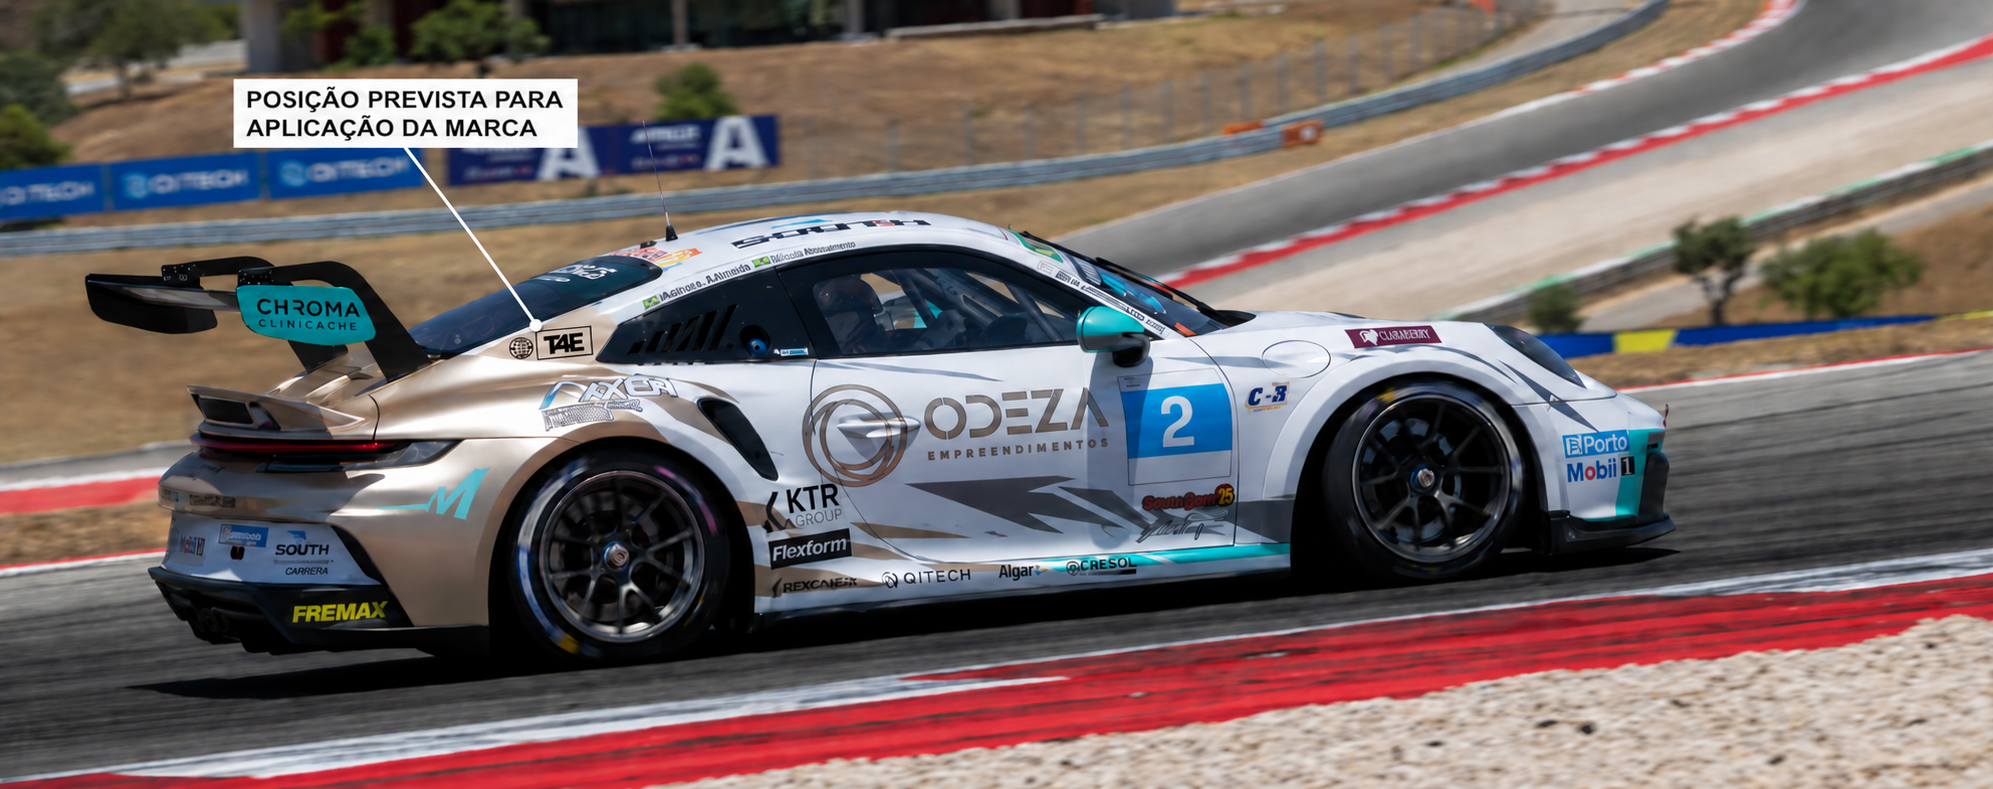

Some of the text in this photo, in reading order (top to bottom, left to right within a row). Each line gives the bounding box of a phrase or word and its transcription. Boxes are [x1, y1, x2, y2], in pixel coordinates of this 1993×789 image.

[257, 298, 360, 318] CHROMA
[258, 319, 357, 331] CLINICACHE
[924, 387, 1109, 440] ODEZA
[1161, 395, 1195, 448] 2
[927, 438, 1109, 461] EMPREENDIMENTOS
[1583, 434, 1628, 454] Porto
[1622, 457, 1632, 475] 1
[786, 483, 840, 514] KTR
[1218, 487, 1235, 505] 25
[795, 508, 843, 528] GROUP
[275, 544, 330, 556] SOUTH
[772, 537, 847, 562] Flexform
[285, 567, 329, 576] CARRERA
[999, 564, 1034, 581] Algar
[1081, 557, 1137, 571] CRESOL
[903, 569, 971, 584] QITECH
[292, 601, 388, 623] FREMAX
